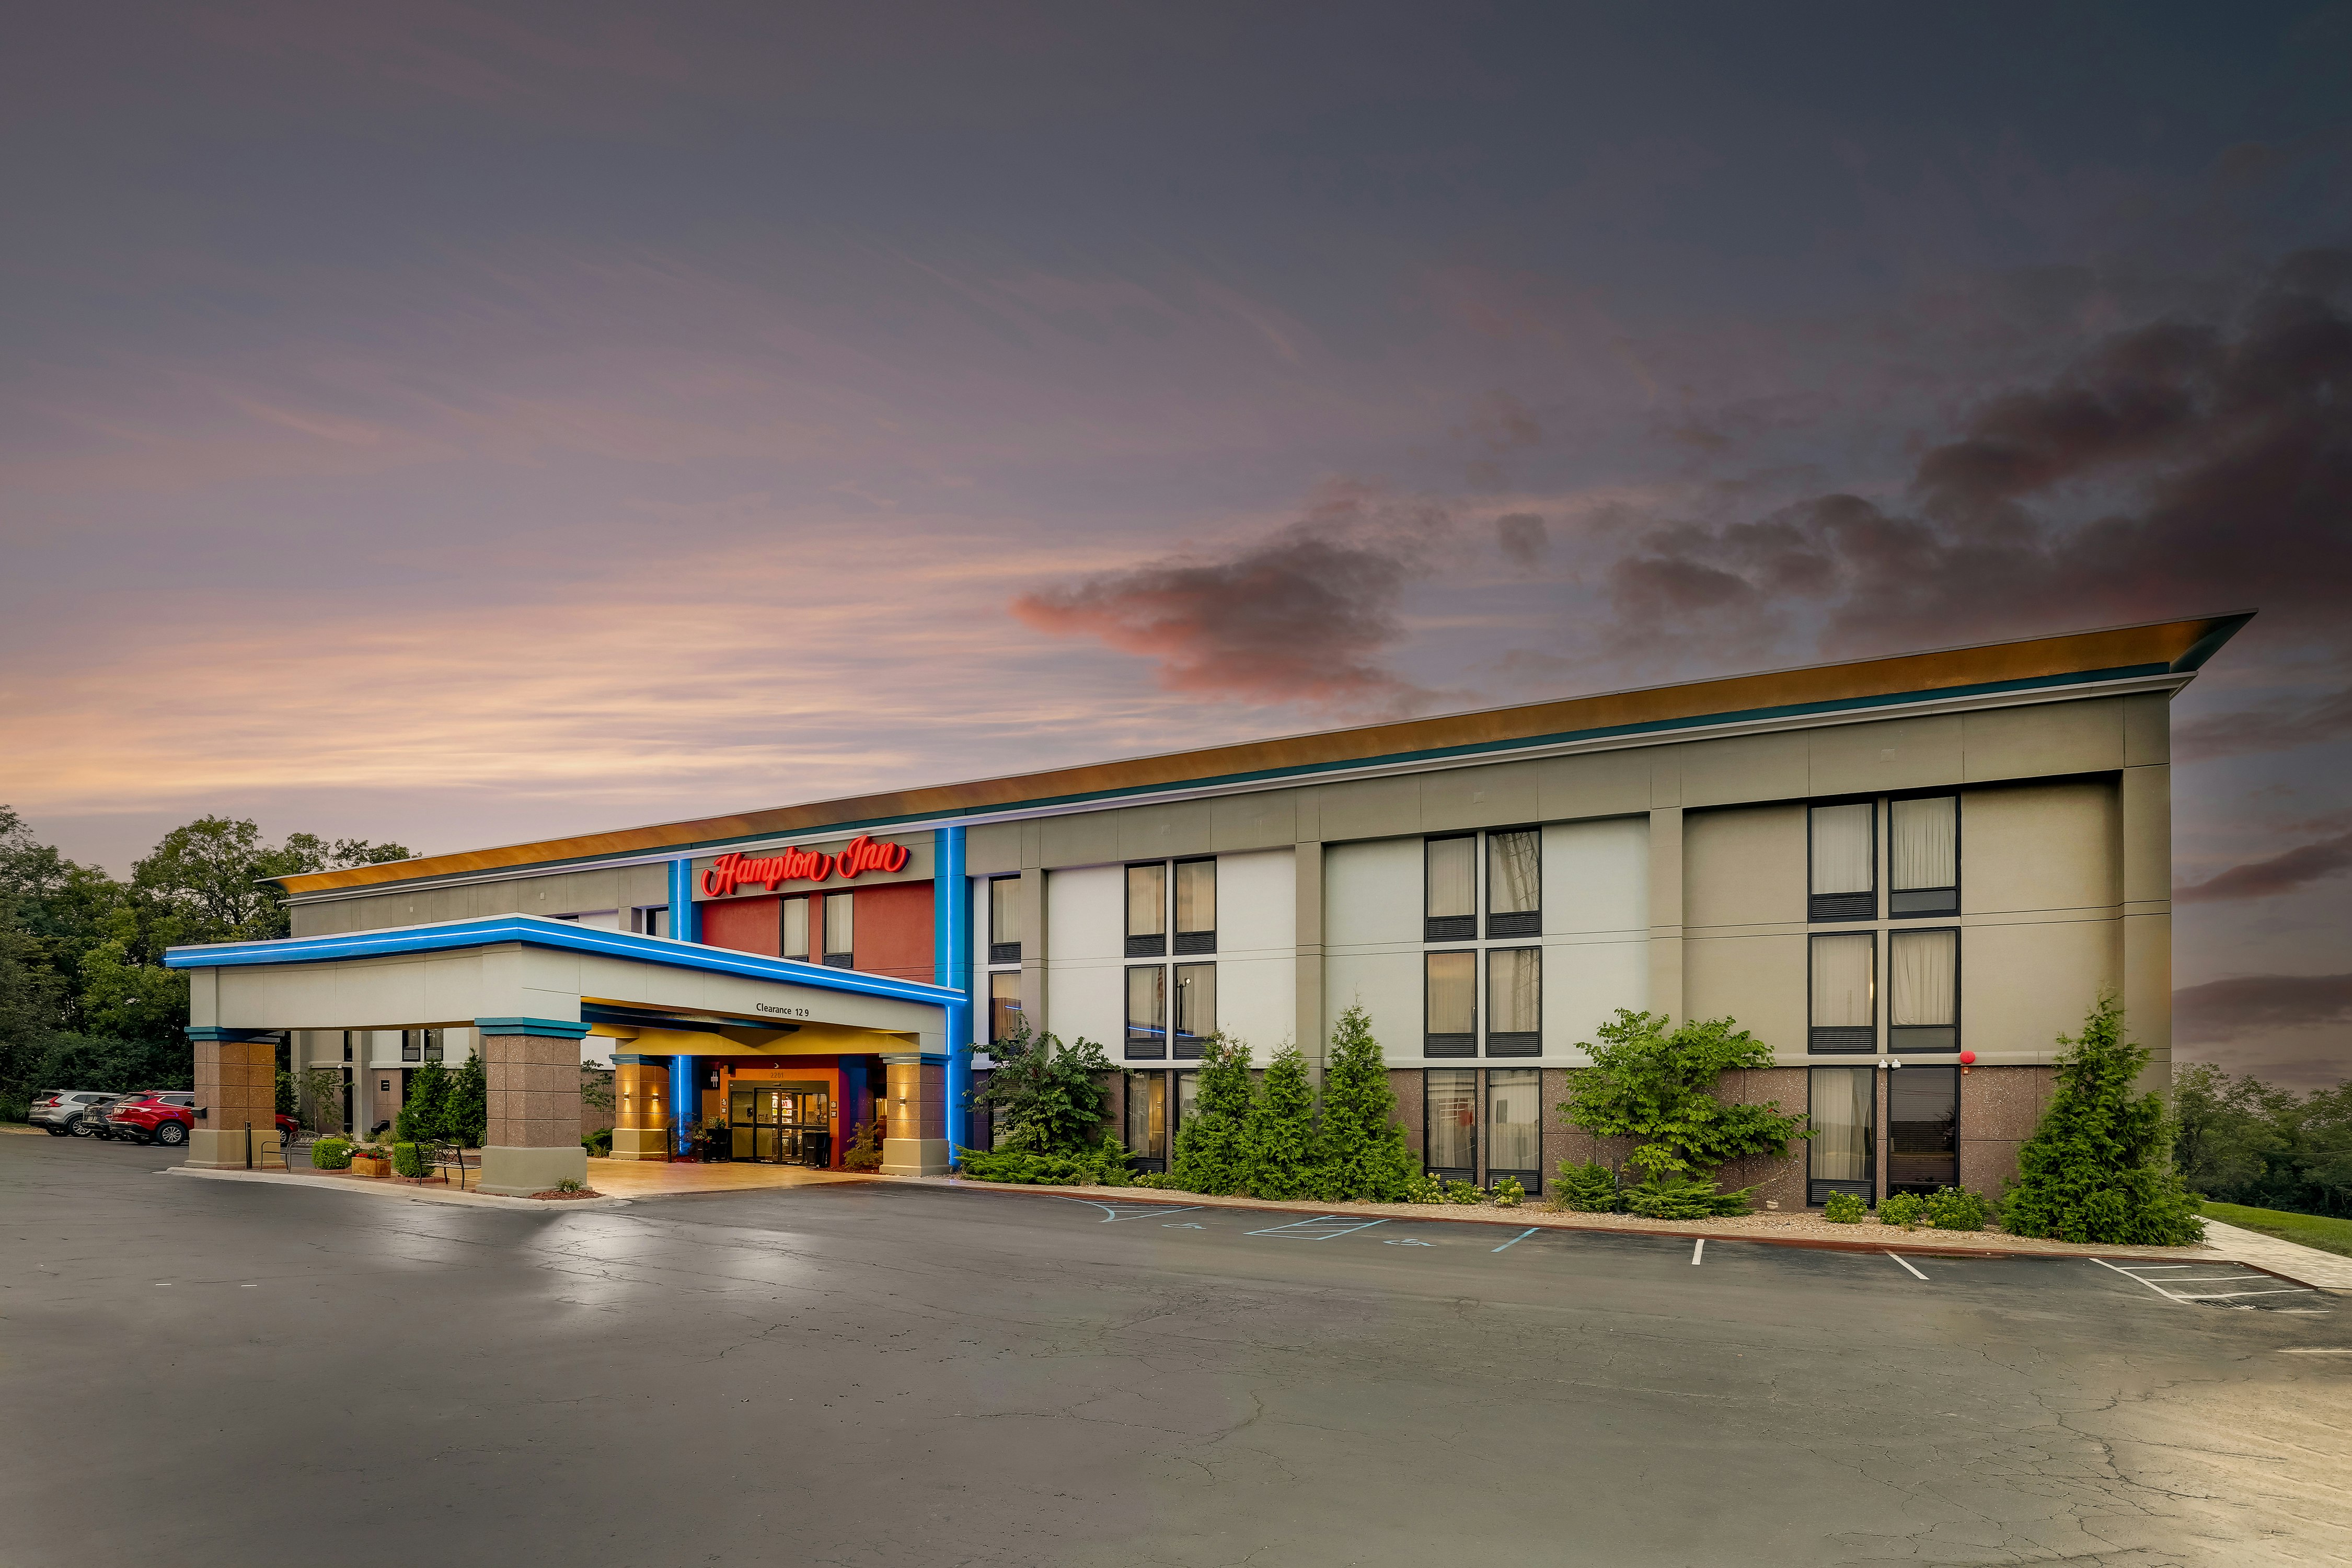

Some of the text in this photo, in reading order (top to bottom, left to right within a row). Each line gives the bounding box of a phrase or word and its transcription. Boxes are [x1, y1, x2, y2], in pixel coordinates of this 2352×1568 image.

[701, 835, 911, 897] Hampton Inn
[756, 1003, 792, 1014] Clearance
